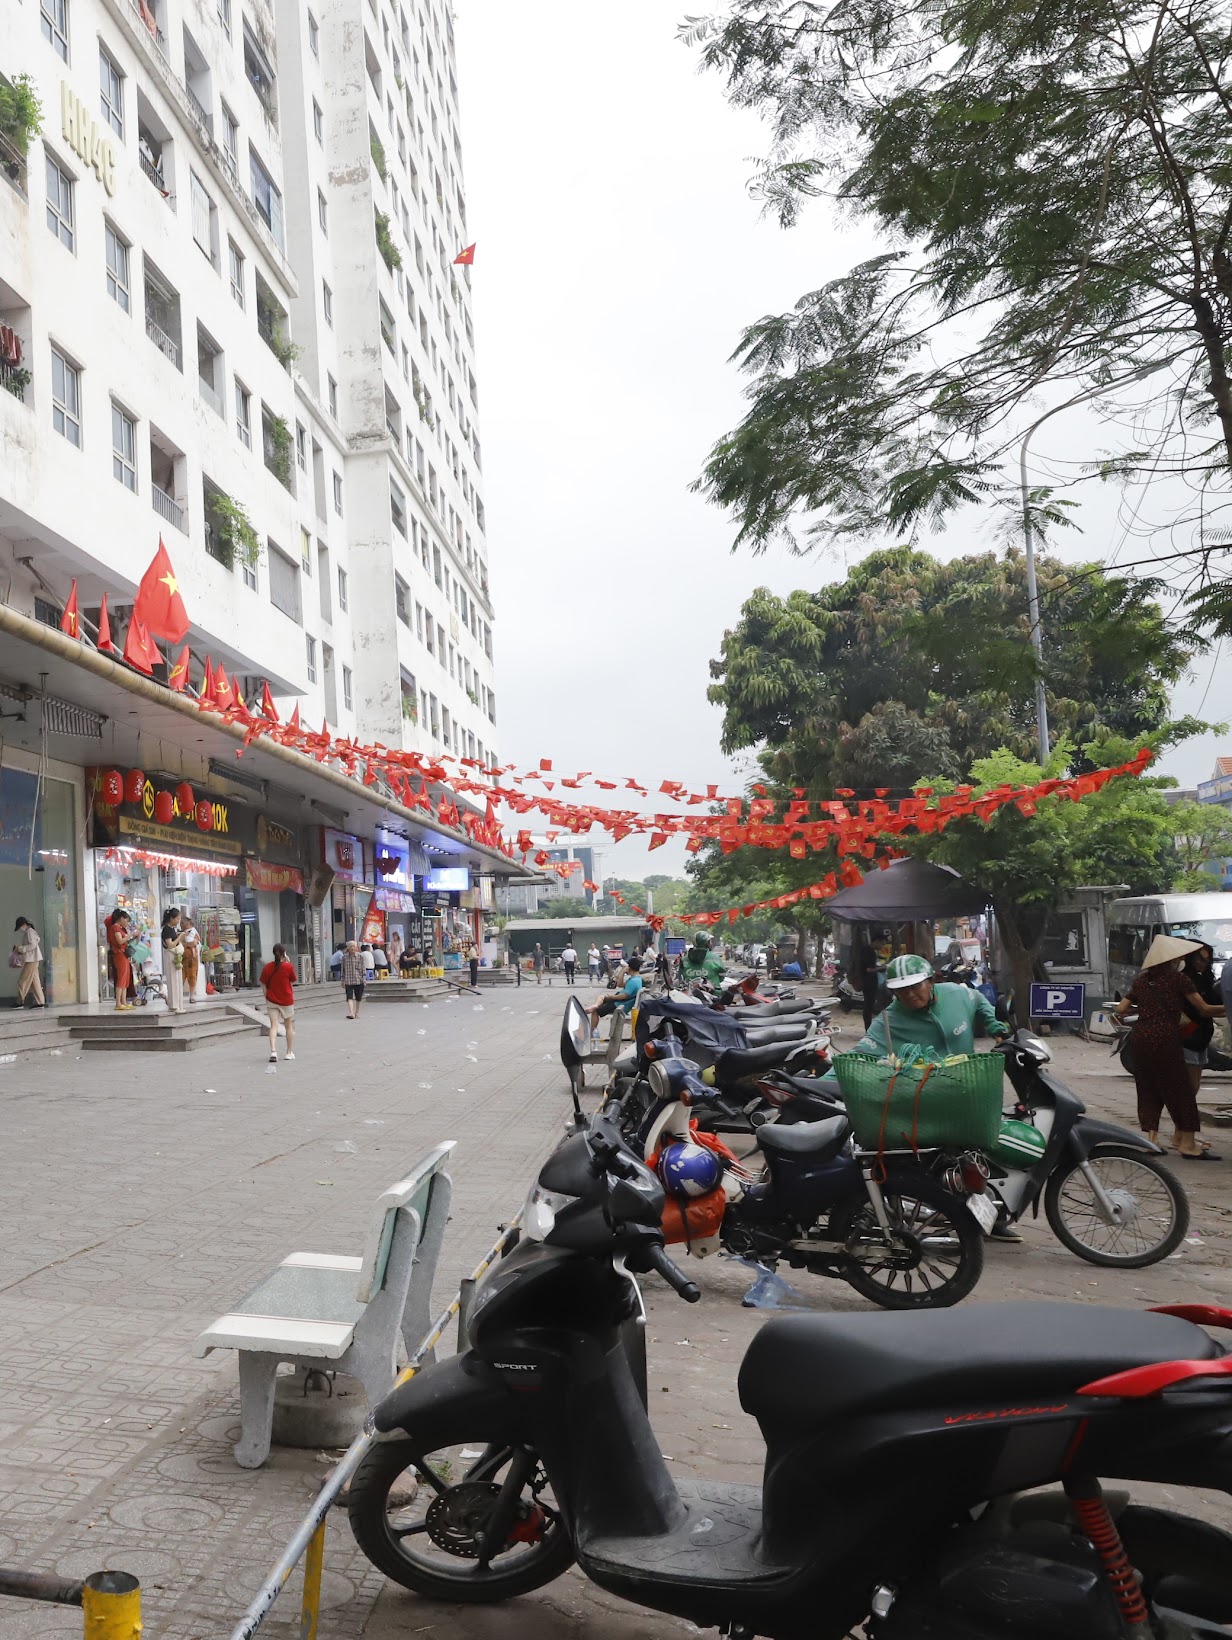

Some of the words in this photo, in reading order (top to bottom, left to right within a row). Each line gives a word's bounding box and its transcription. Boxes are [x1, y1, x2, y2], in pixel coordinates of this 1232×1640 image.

[61, 80, 116, 197] HH4C
[686, 968, 708, 976] Grab
[1047, 990, 1066, 1010] P
[953, 1020, 968, 1036] Grab
[493, 1362, 538, 1370] SPORT
